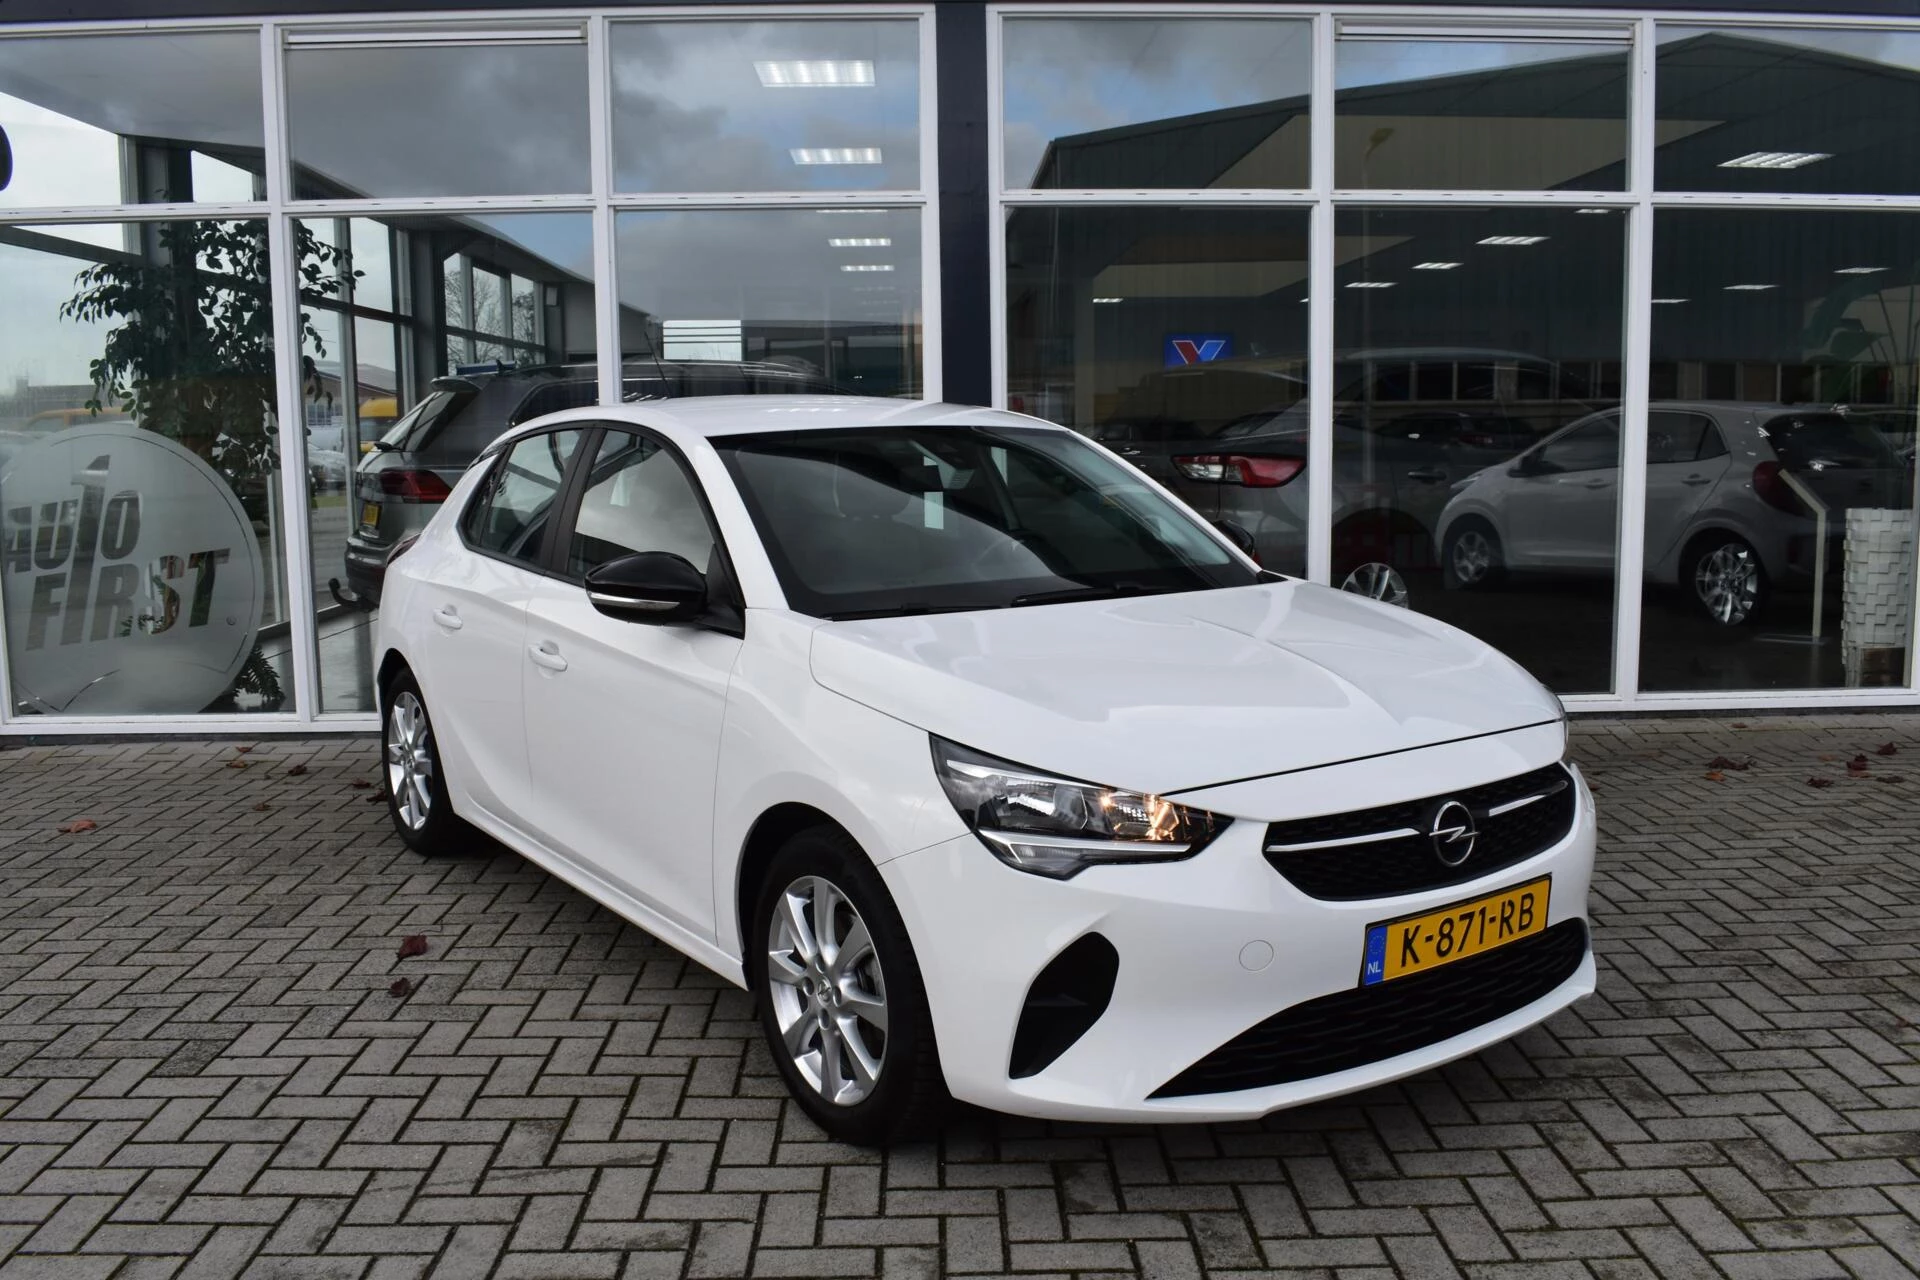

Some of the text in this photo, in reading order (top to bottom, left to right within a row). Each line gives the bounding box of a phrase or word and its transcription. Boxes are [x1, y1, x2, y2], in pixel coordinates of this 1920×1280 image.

[26, 548, 230, 651] FIRST
[1401, 893, 1535, 968] K-871-RB
[1367, 962, 1381, 975] NL
